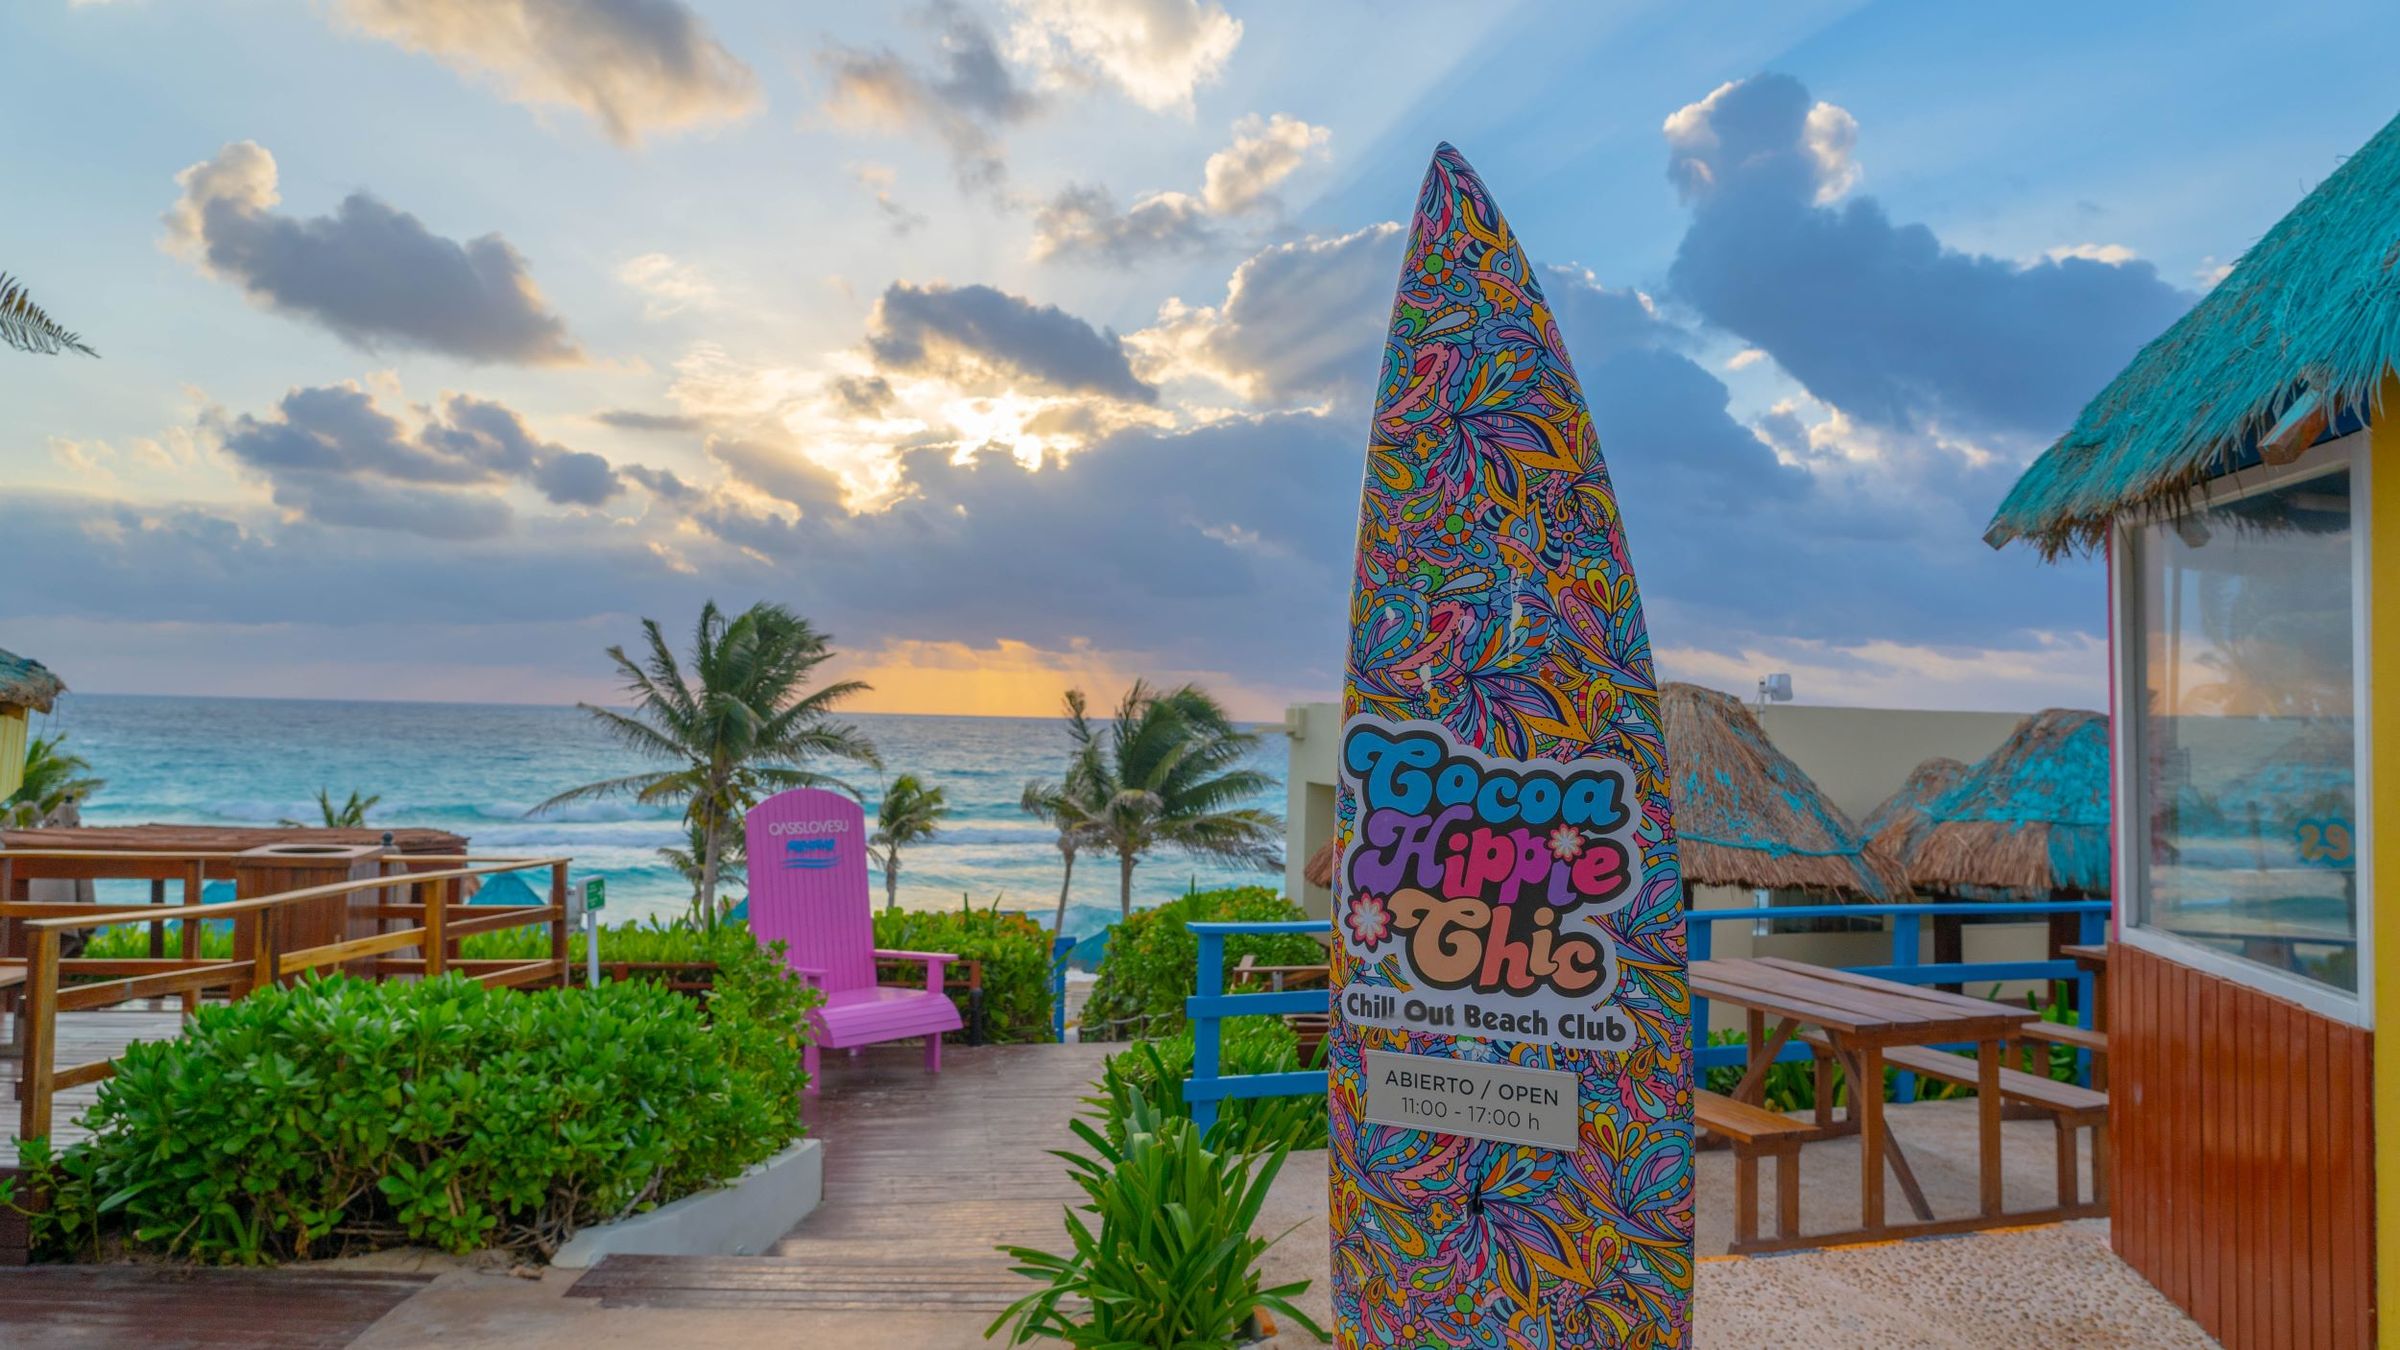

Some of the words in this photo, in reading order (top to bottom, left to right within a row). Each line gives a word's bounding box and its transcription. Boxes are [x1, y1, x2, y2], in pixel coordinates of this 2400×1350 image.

[1346, 731, 1622, 826] Cocoa
[1352, 804, 1622, 906] Hippie
[1387, 888, 1599, 990] Chic
[1347, 993, 1395, 1019] Chill
[1404, 999, 1455, 1026] Out
[1464, 1004, 1548, 1036] Beach
[1558, 1013, 1627, 1042] Club
[1385, 1070, 1474, 1096] ABIERTO
[1499, 1084, 1558, 1106] OPEN
[1401, 1097, 1447, 1118] 11:00
[1468, 1106, 1521, 1128] 17:00
[1528, 1112, 1540, 1131] h
